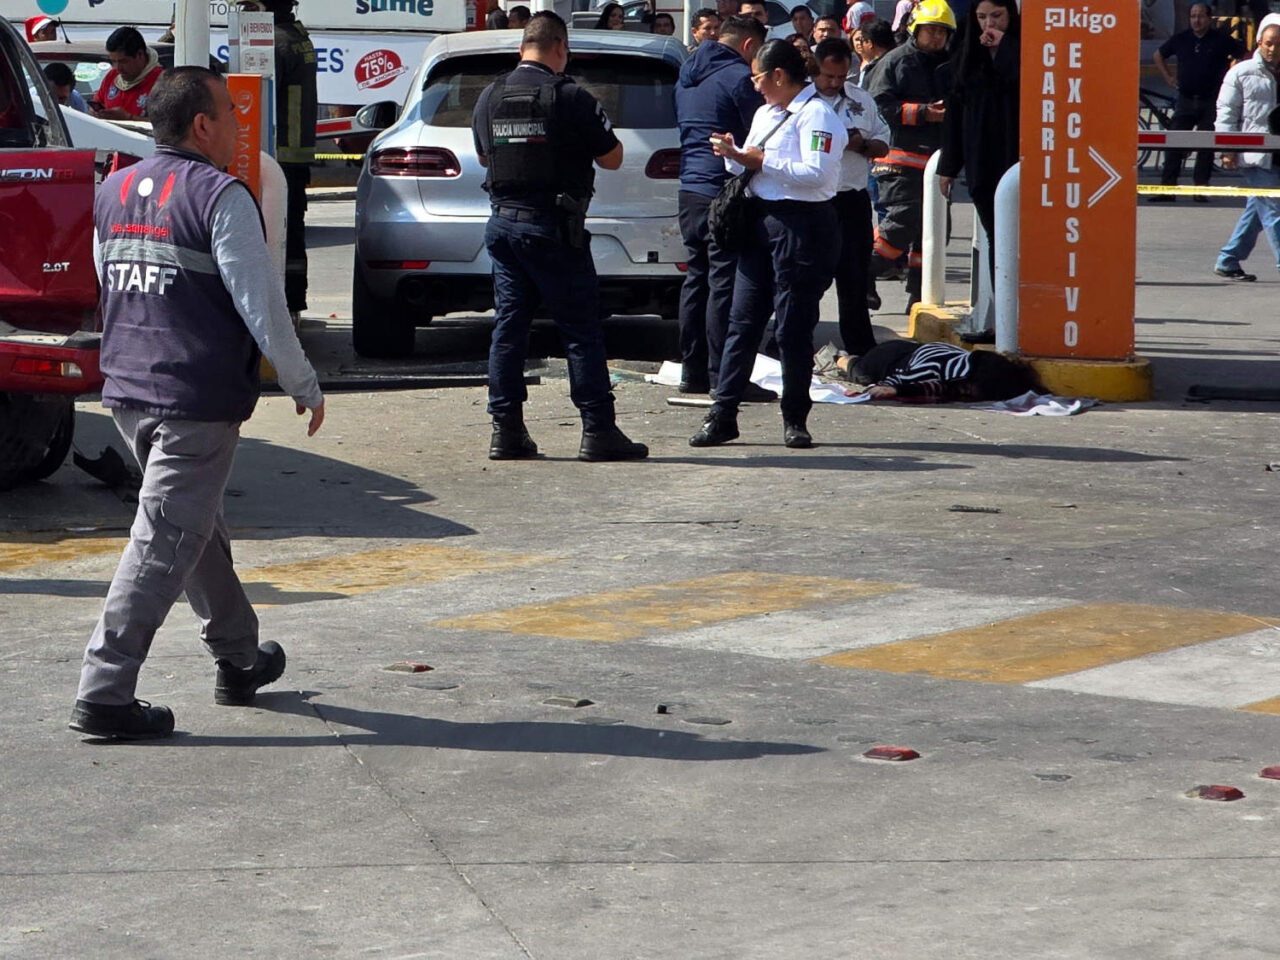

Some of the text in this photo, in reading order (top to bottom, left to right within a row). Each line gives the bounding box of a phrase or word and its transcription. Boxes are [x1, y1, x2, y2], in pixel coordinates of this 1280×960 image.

[1070, 7, 1116, 34] kigo
[361, 54, 394, 79] 75%
[364, 51, 384, 62] HASTA
[513, 122, 546, 136] MUNICIPAL
[1041, 43, 1056, 207] CARRIL
[1064, 43, 1082, 348] EXCLUSIVO
[42, 262, 70, 272] 2.0T
[107, 263, 177, 295] STAFF
